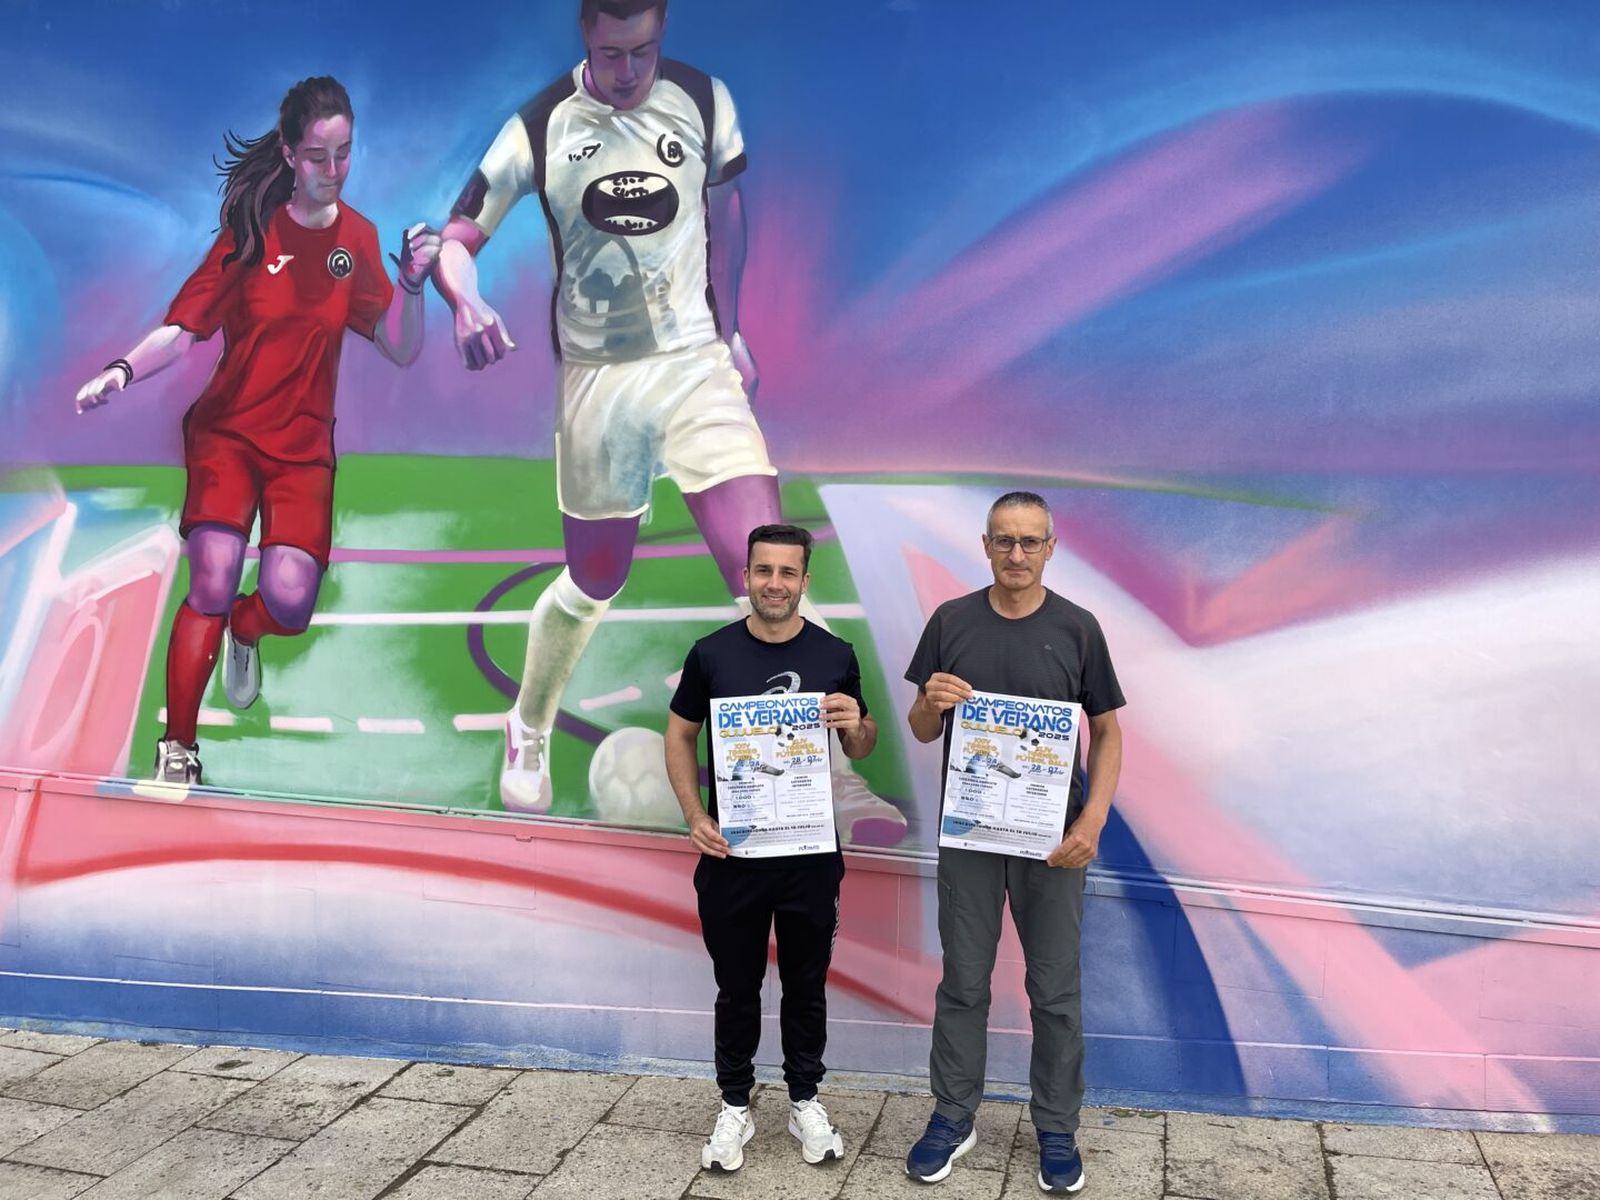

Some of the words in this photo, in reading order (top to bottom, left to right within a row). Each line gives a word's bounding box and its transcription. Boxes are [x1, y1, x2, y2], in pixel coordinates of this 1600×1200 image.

[719, 697, 818, 712] CAMPEONATOS
[966, 696, 1072, 716] CAMPEONATOS
[719, 712, 742, 729] DE
[745, 707, 821, 727] VERANO
[791, 722, 821, 731] 2025
[962, 704, 988, 722] DE
[991, 708, 1073, 733] VERANO
[1038, 731, 1070, 741] 2025
